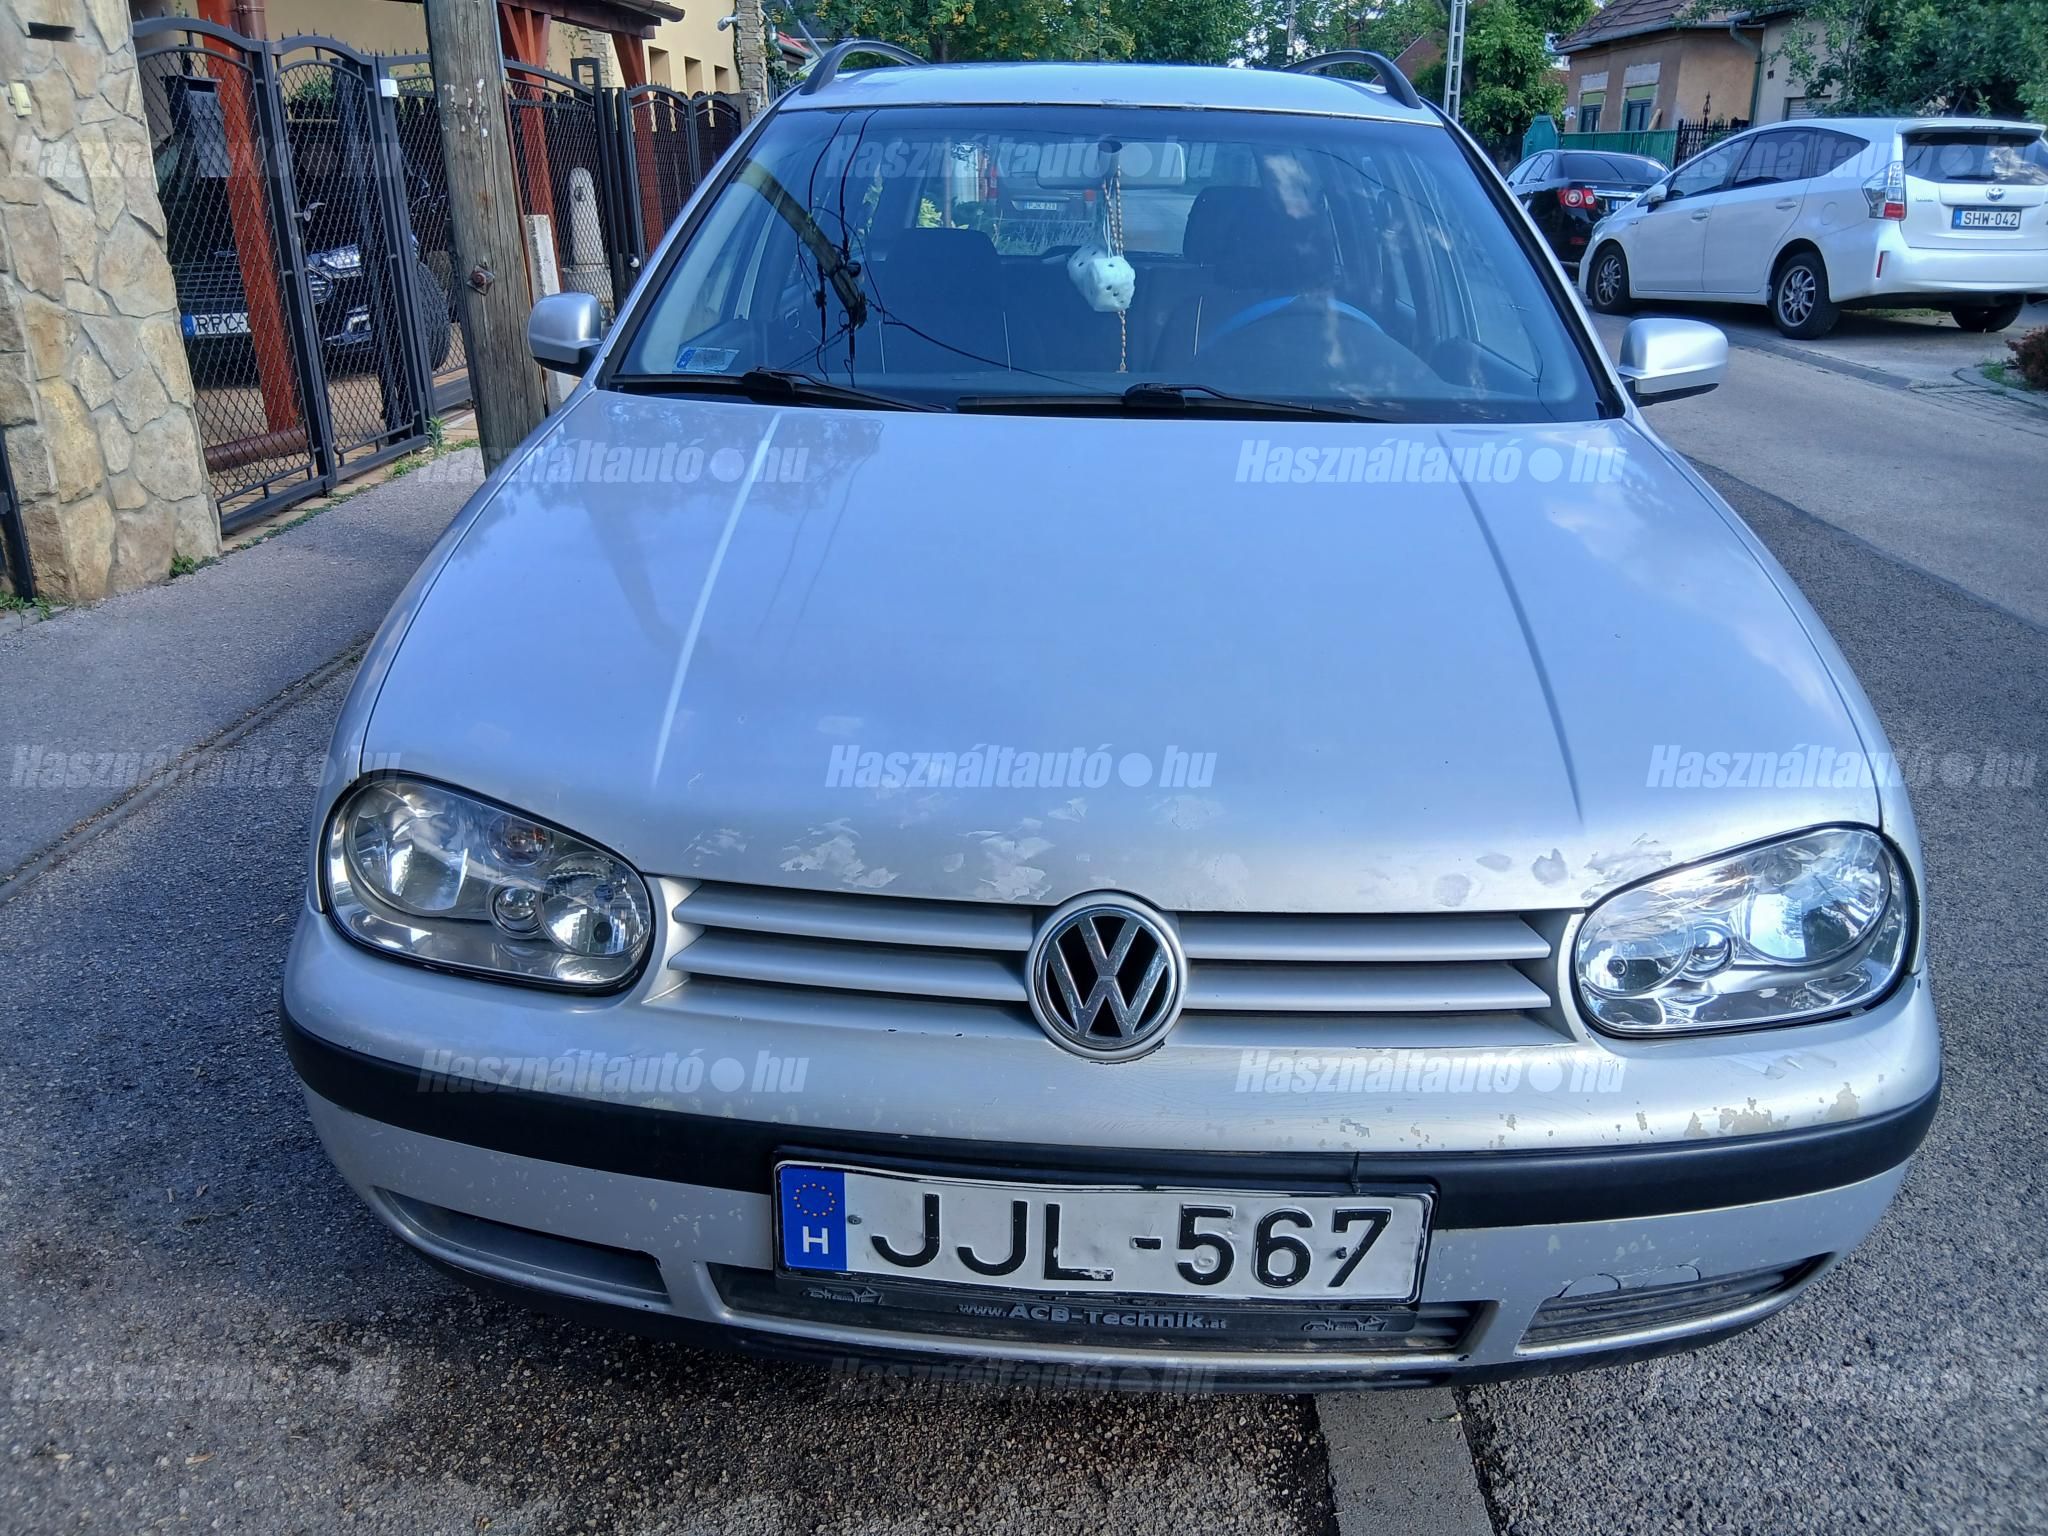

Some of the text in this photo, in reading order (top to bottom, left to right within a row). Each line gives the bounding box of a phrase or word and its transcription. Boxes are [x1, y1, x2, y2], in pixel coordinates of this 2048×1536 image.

[1963, 212, 2017, 226] SHW-042
[802, 1192, 1392, 1289] H JJL-567
